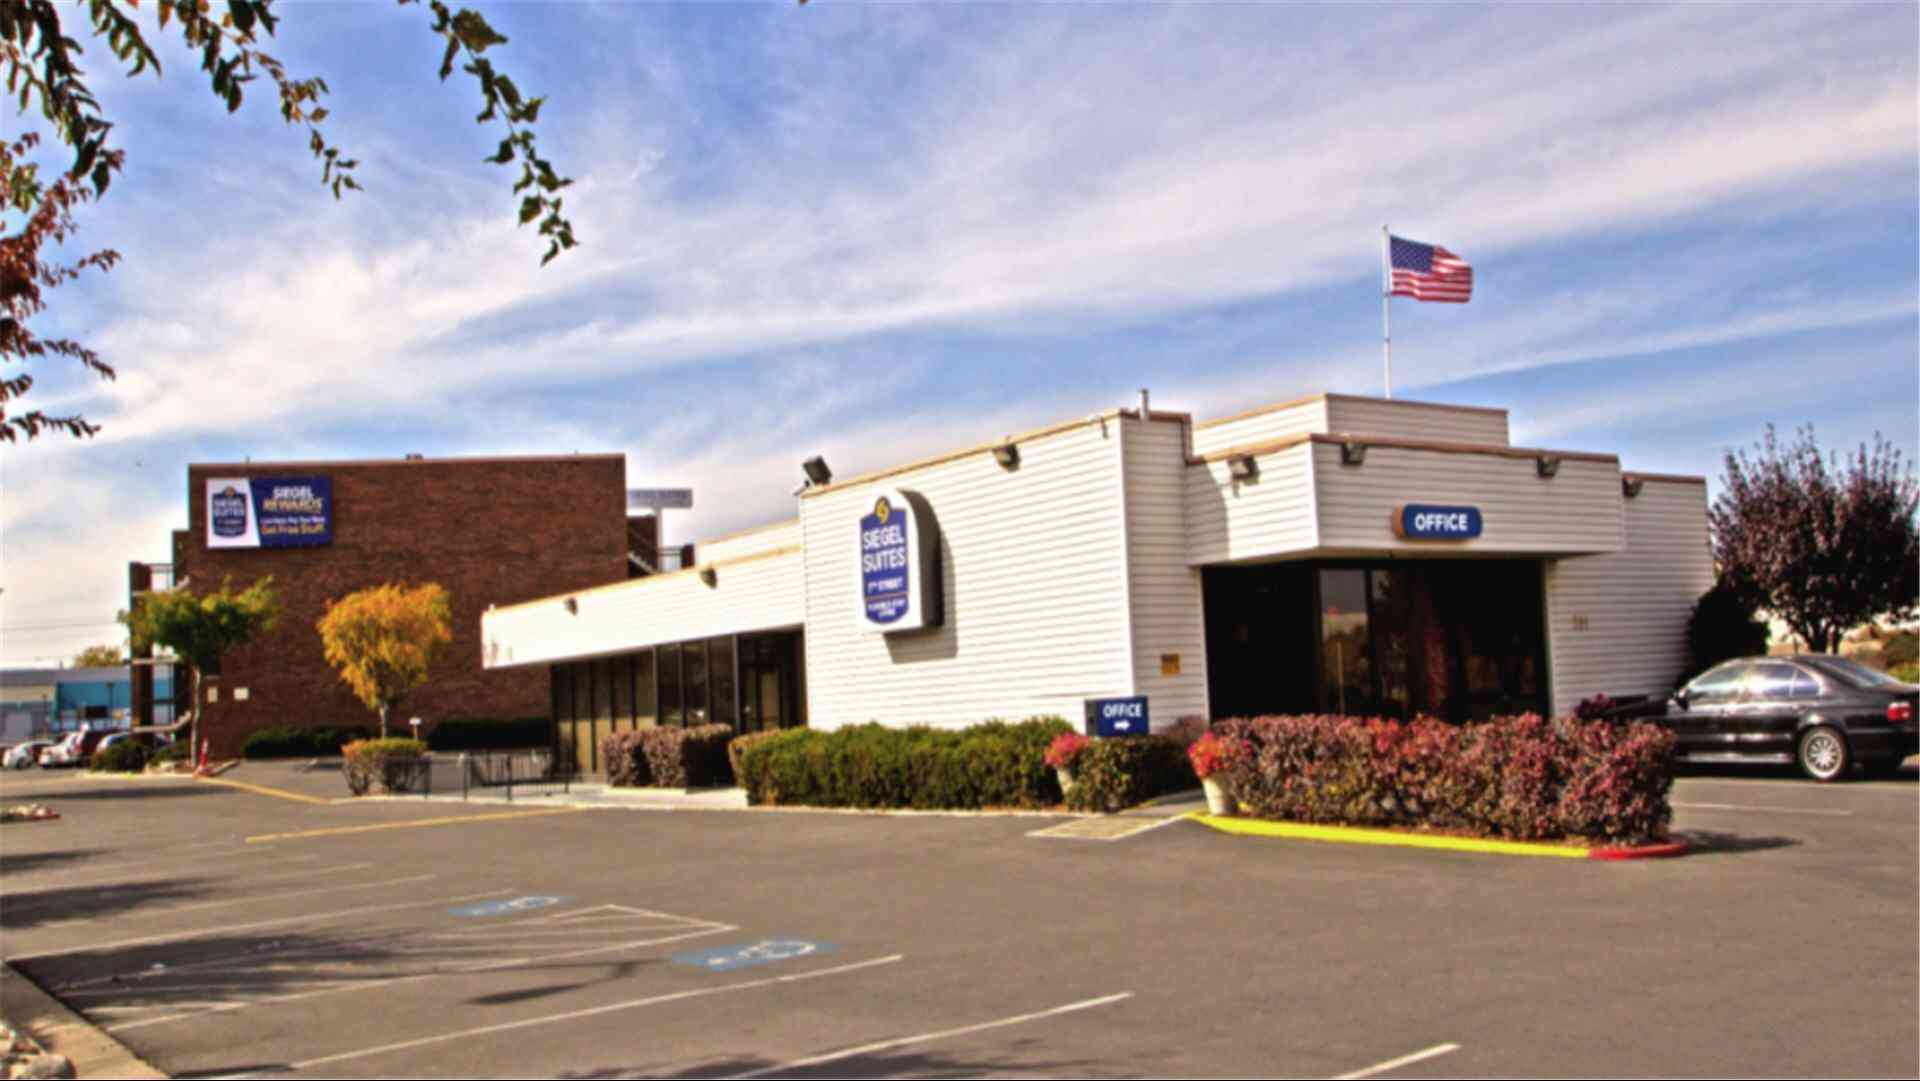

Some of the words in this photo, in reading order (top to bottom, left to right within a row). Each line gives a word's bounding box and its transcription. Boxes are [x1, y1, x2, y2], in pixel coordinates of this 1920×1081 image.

[273, 486, 314, 499] SIEGEL
[263, 498, 323, 512] REWARDS
[1414, 513, 1468, 531] OFFICE
[863, 525, 905, 550] SIEGEL
[863, 547, 905, 573] SUITES
[1103, 703, 1142, 717] OFFICE
